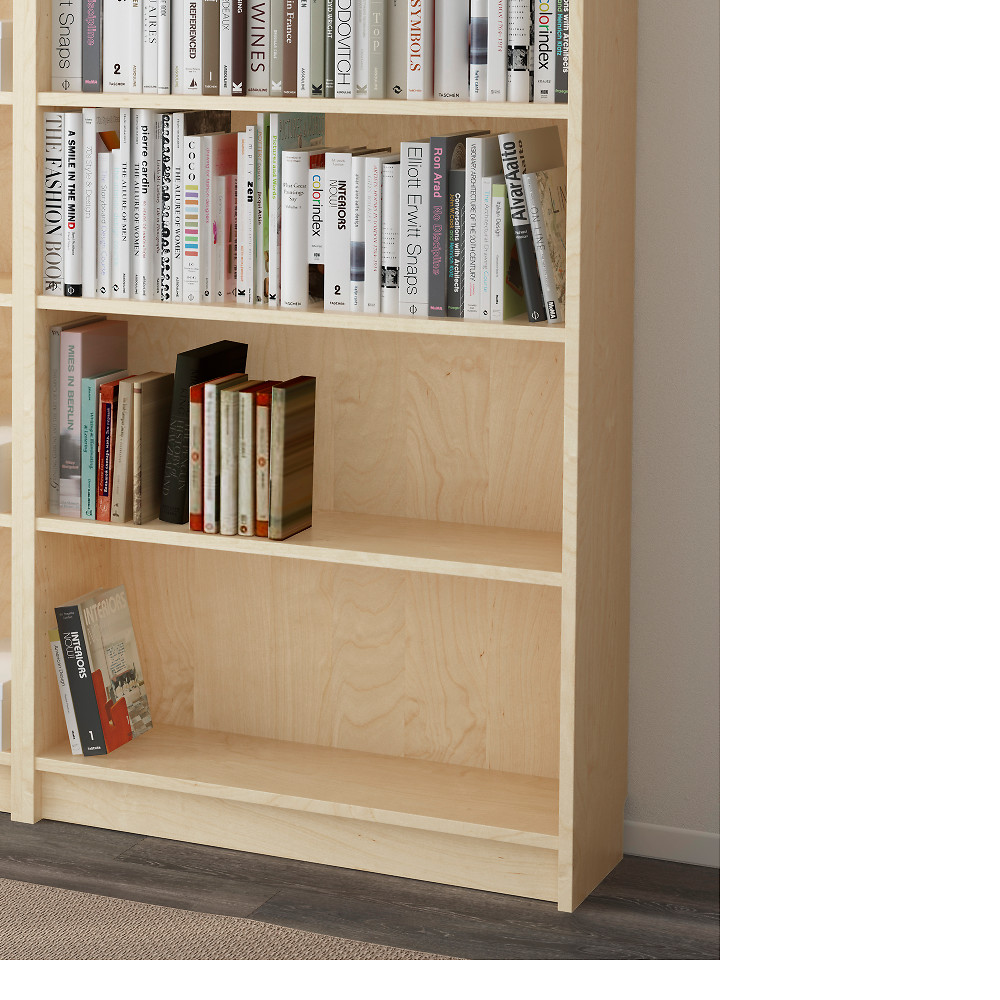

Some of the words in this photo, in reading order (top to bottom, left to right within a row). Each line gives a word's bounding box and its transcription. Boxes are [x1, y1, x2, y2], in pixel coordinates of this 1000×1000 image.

[286, 1, 295, 10] in
[56, 13, 75, 69] Snaps
[189, 2, 197, 59] REFERENCED
[250, 2, 266, 72] WINES
[286, 11, 295, 44] France
[409, 0, 422, 72] SYMBOLS
[113, 63, 121, 75] 2
[45, 115, 62, 153] THE
[141, 125, 149, 157] pierre
[67, 140, 75, 169] SMILE
[407, 147, 423, 189] Elliott
[433, 147, 443, 170] Ron
[502, 141, 519, 181] Aalto
[67, 171, 75, 180] IN
[67, 184, 75, 201] THE
[142, 160, 150, 194] cardin
[329, 180, 338, 208] NOW!
[433, 172, 443, 198] Arad
[44, 157, 62, 235] FASHION
[311, 174, 323, 237] colorindex
[338, 180, 346, 230] INTERIORS
[432, 205, 442, 222] No
[510, 180, 528, 221] Alvar
[67, 204, 75, 230] MIND
[407, 194, 423, 239] Erwitt
[44, 241, 62, 291] BOOK
[404, 243, 422, 295] Snaps
[67, 344, 75, 373] MIES
[67, 376, 75, 387] IN
[67, 390, 75, 431] BERLIN
[70, 631, 87, 679] INTERIORS
